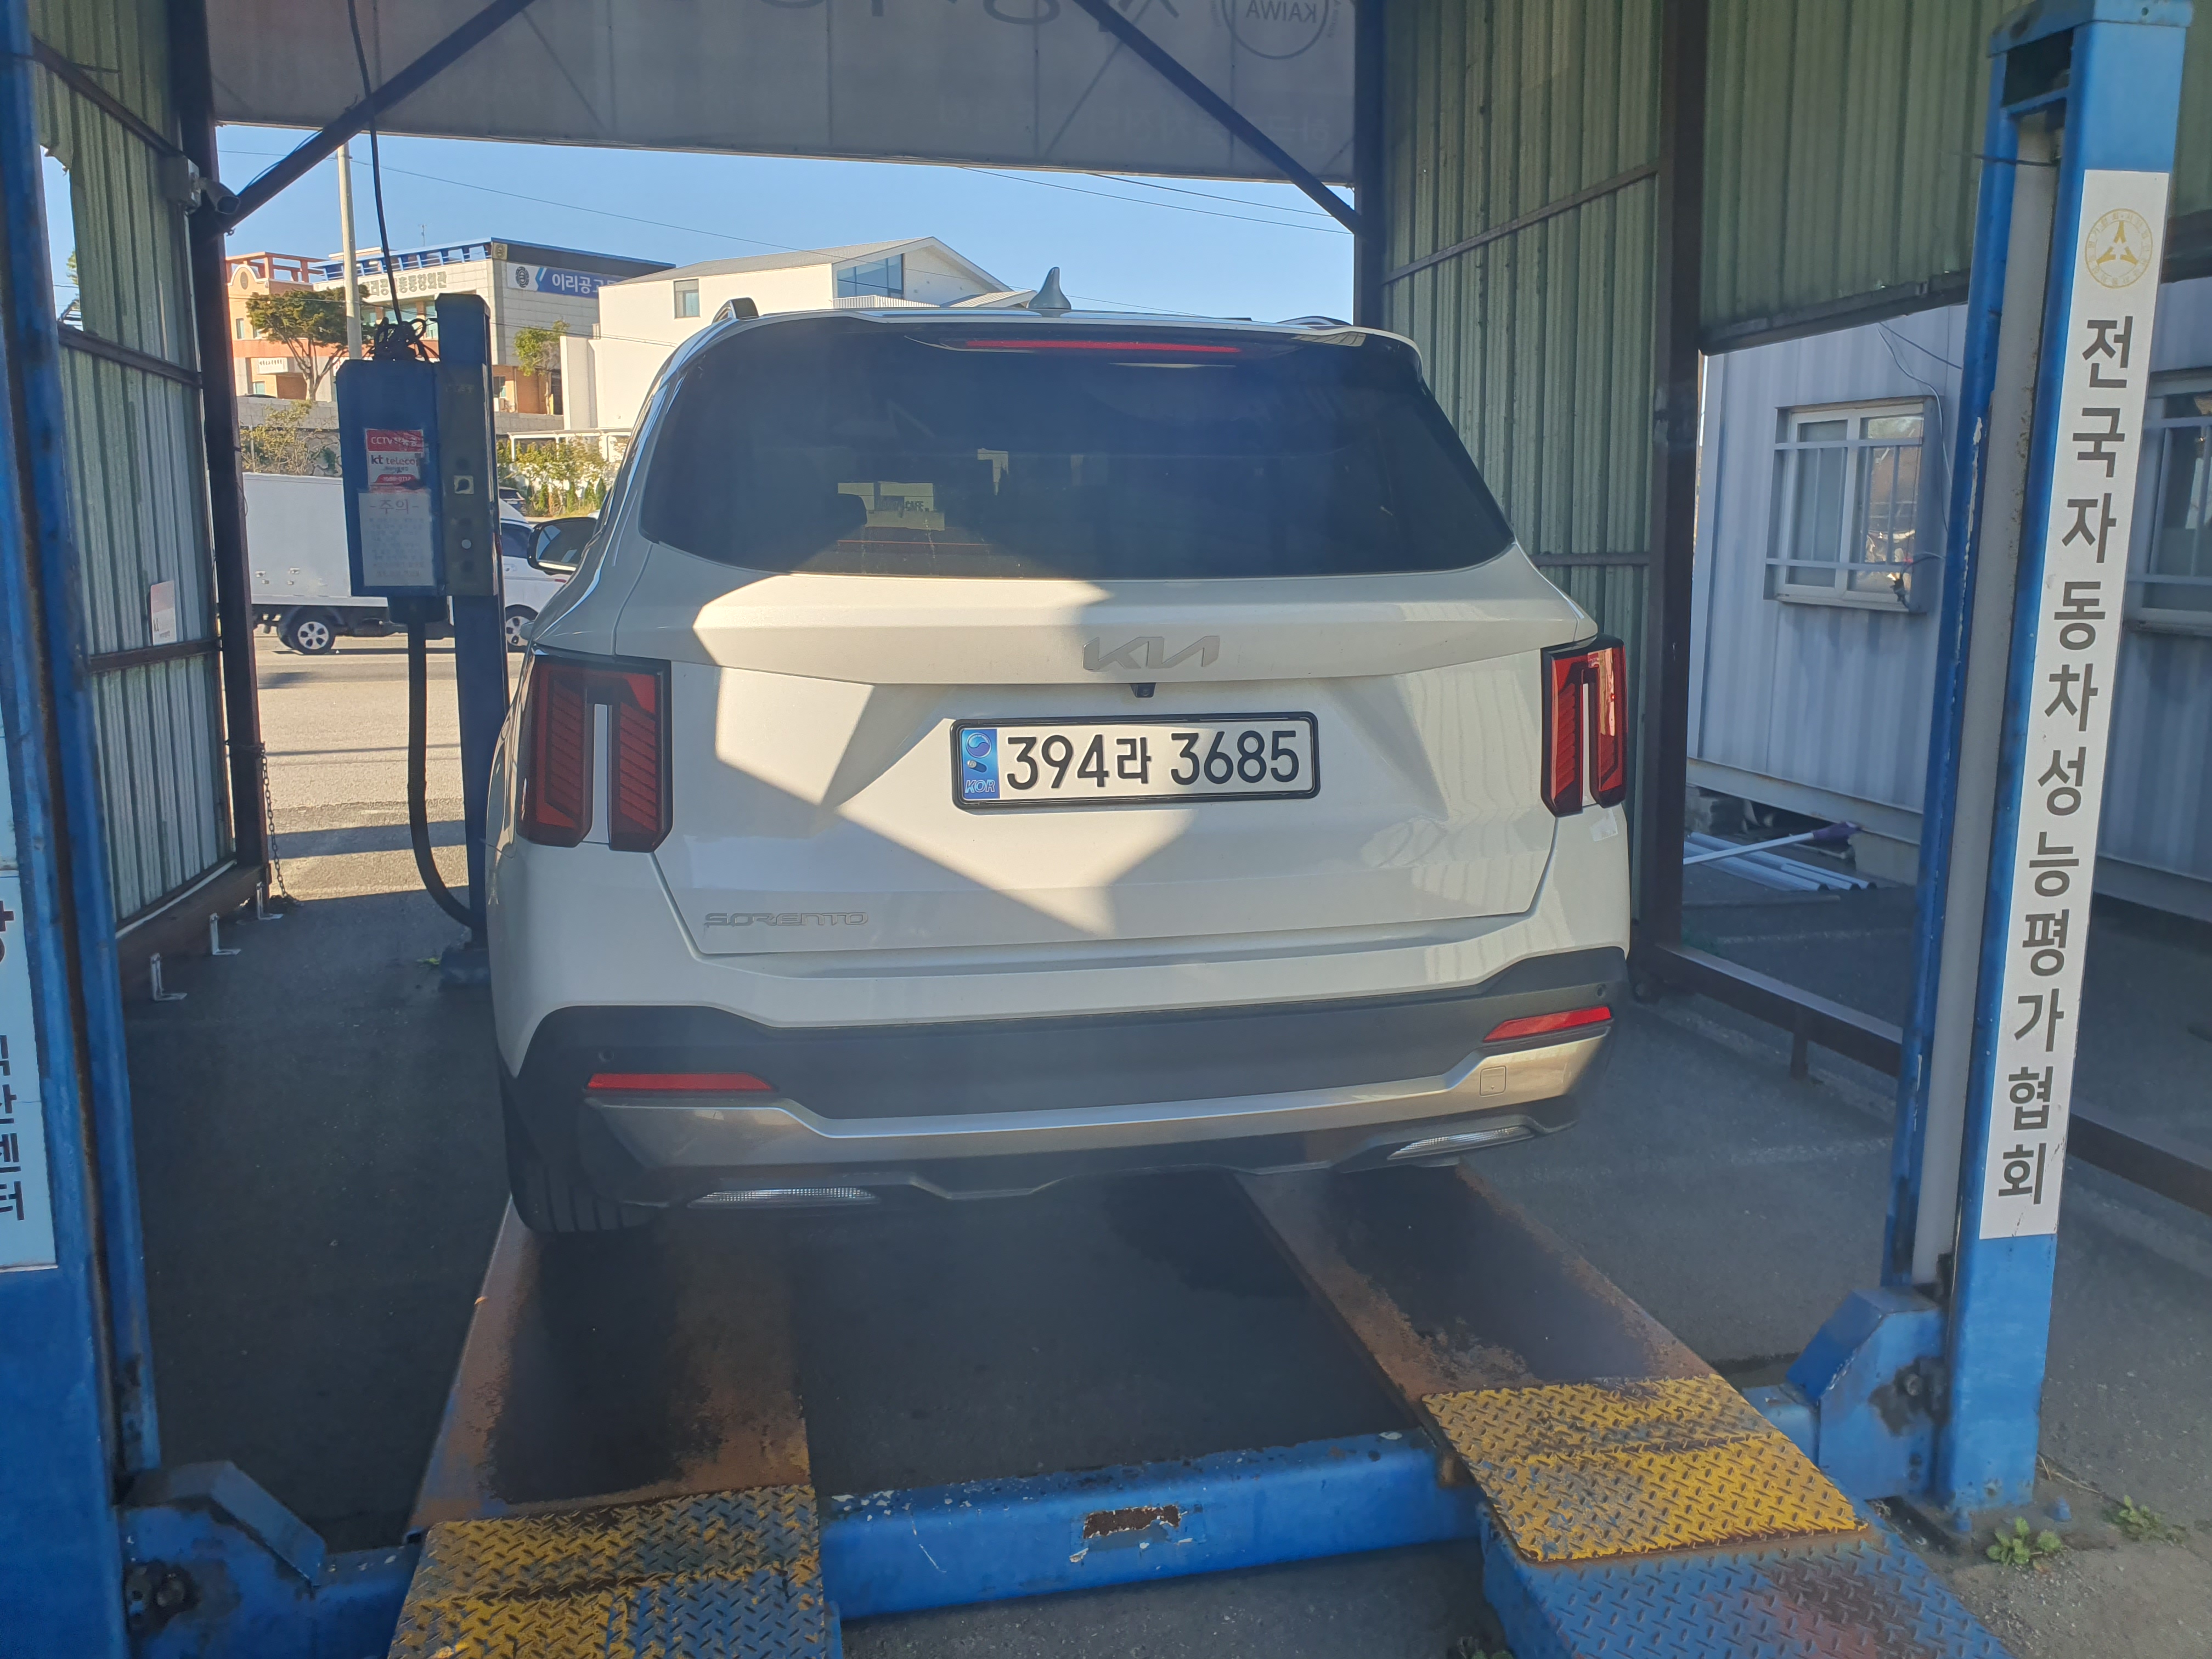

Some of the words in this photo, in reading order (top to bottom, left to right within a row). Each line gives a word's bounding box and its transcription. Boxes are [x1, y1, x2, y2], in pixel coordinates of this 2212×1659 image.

[363, 271, 447, 296] 리공총동창회관
[552, 273, 616, 294] 이리공고
[371, 455, 383, 465] kt
[1083, 636, 1220, 671] KIA
[1007, 734, 1151, 790] 394라
[1171, 730, 1299, 785] 3685
[1999, 315, 2133, 1205] 전국자동차성능평가협회
[965, 780, 995, 793] KOR
[704, 911, 868, 927] SORENTO
